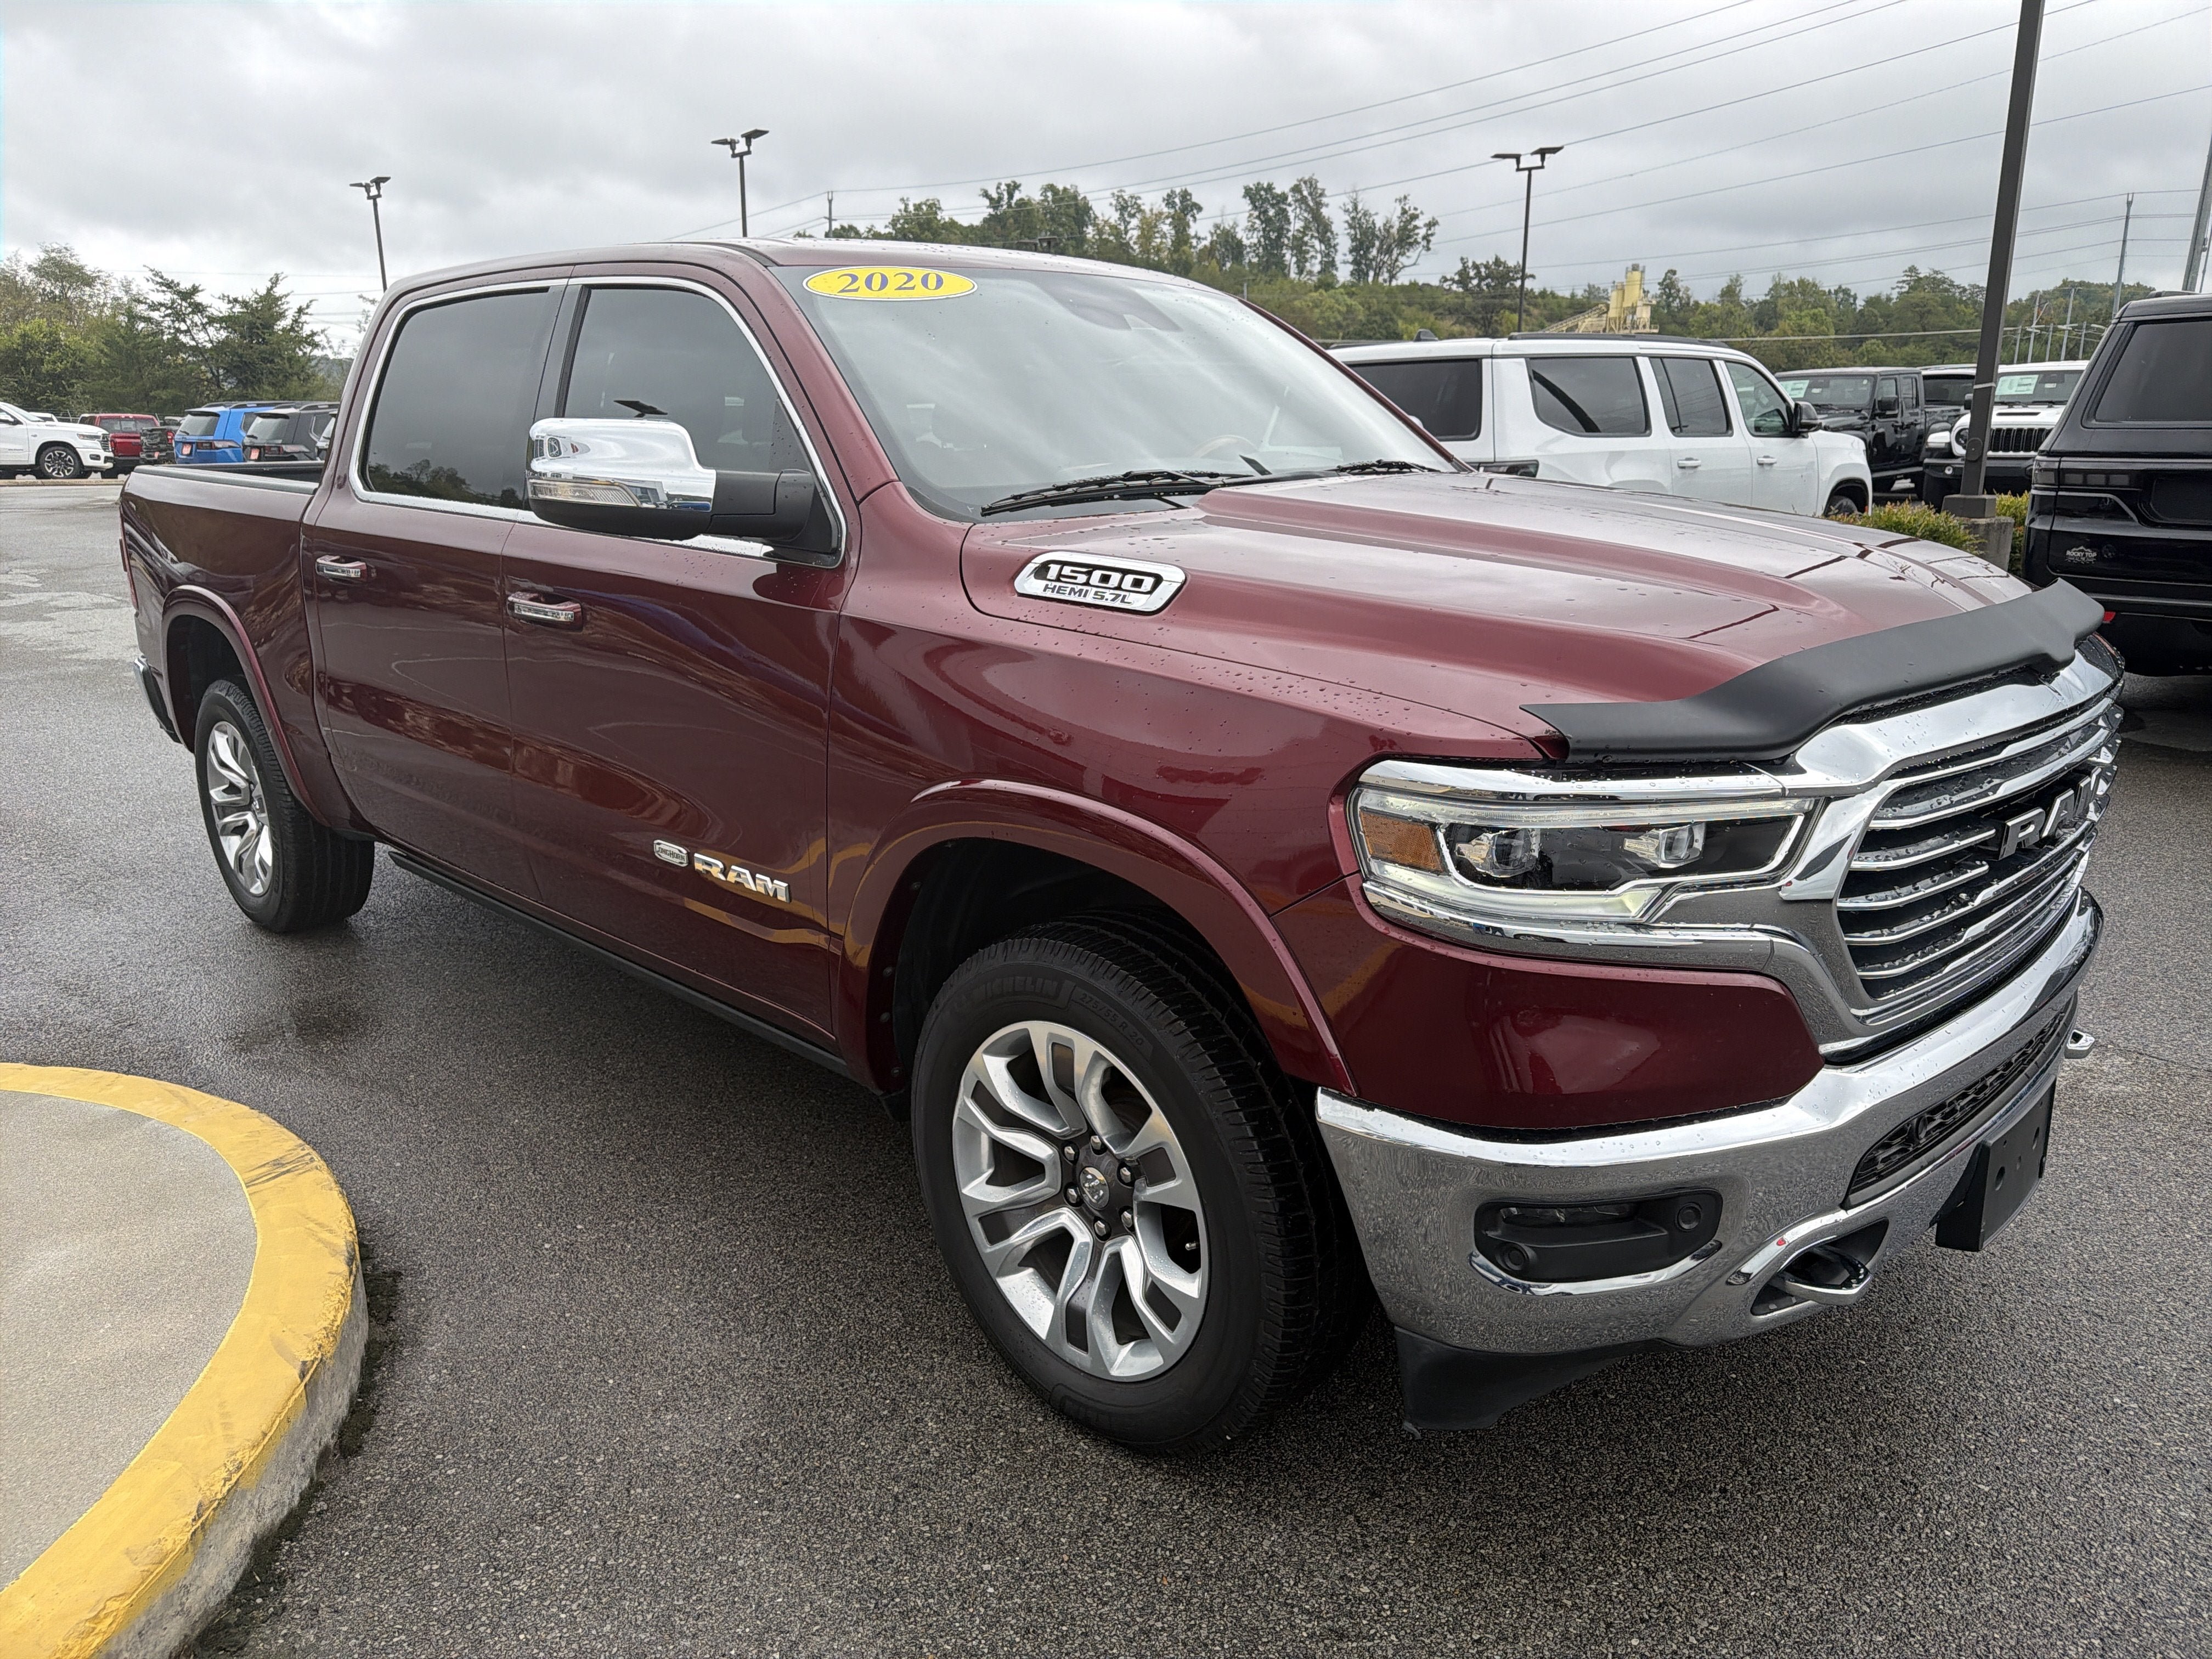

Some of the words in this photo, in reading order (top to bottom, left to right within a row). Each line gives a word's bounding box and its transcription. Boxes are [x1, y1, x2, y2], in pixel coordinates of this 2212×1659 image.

[837, 272, 944, 294] 2020
[1046, 563, 1155, 592] 1500
[1042, 583, 1088, 599] HEMI
[1092, 591, 1133, 605] 5.7L
[654, 845, 686, 862] LONGHORN
[693, 853, 791, 904] RAM
